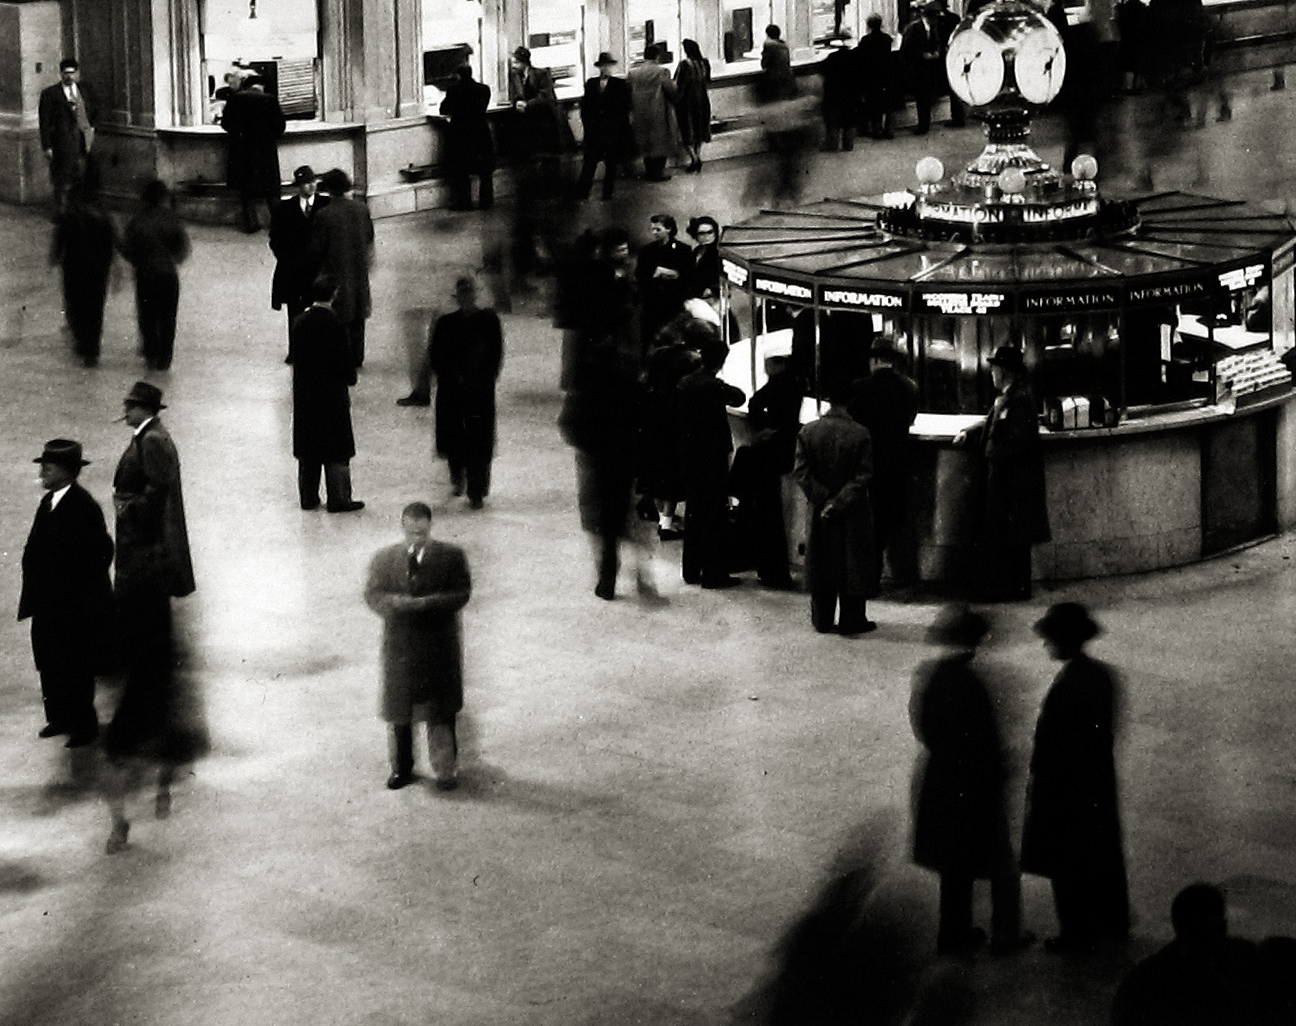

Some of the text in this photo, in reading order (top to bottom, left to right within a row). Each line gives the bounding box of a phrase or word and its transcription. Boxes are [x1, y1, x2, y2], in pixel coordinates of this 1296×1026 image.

[755, 278, 812, 299] INFORMATION
[1130, 282, 1204, 302] INFORMATION
[824, 290, 903, 307] INFORMATION
[1026, 293, 1114, 309] INFORMATION
